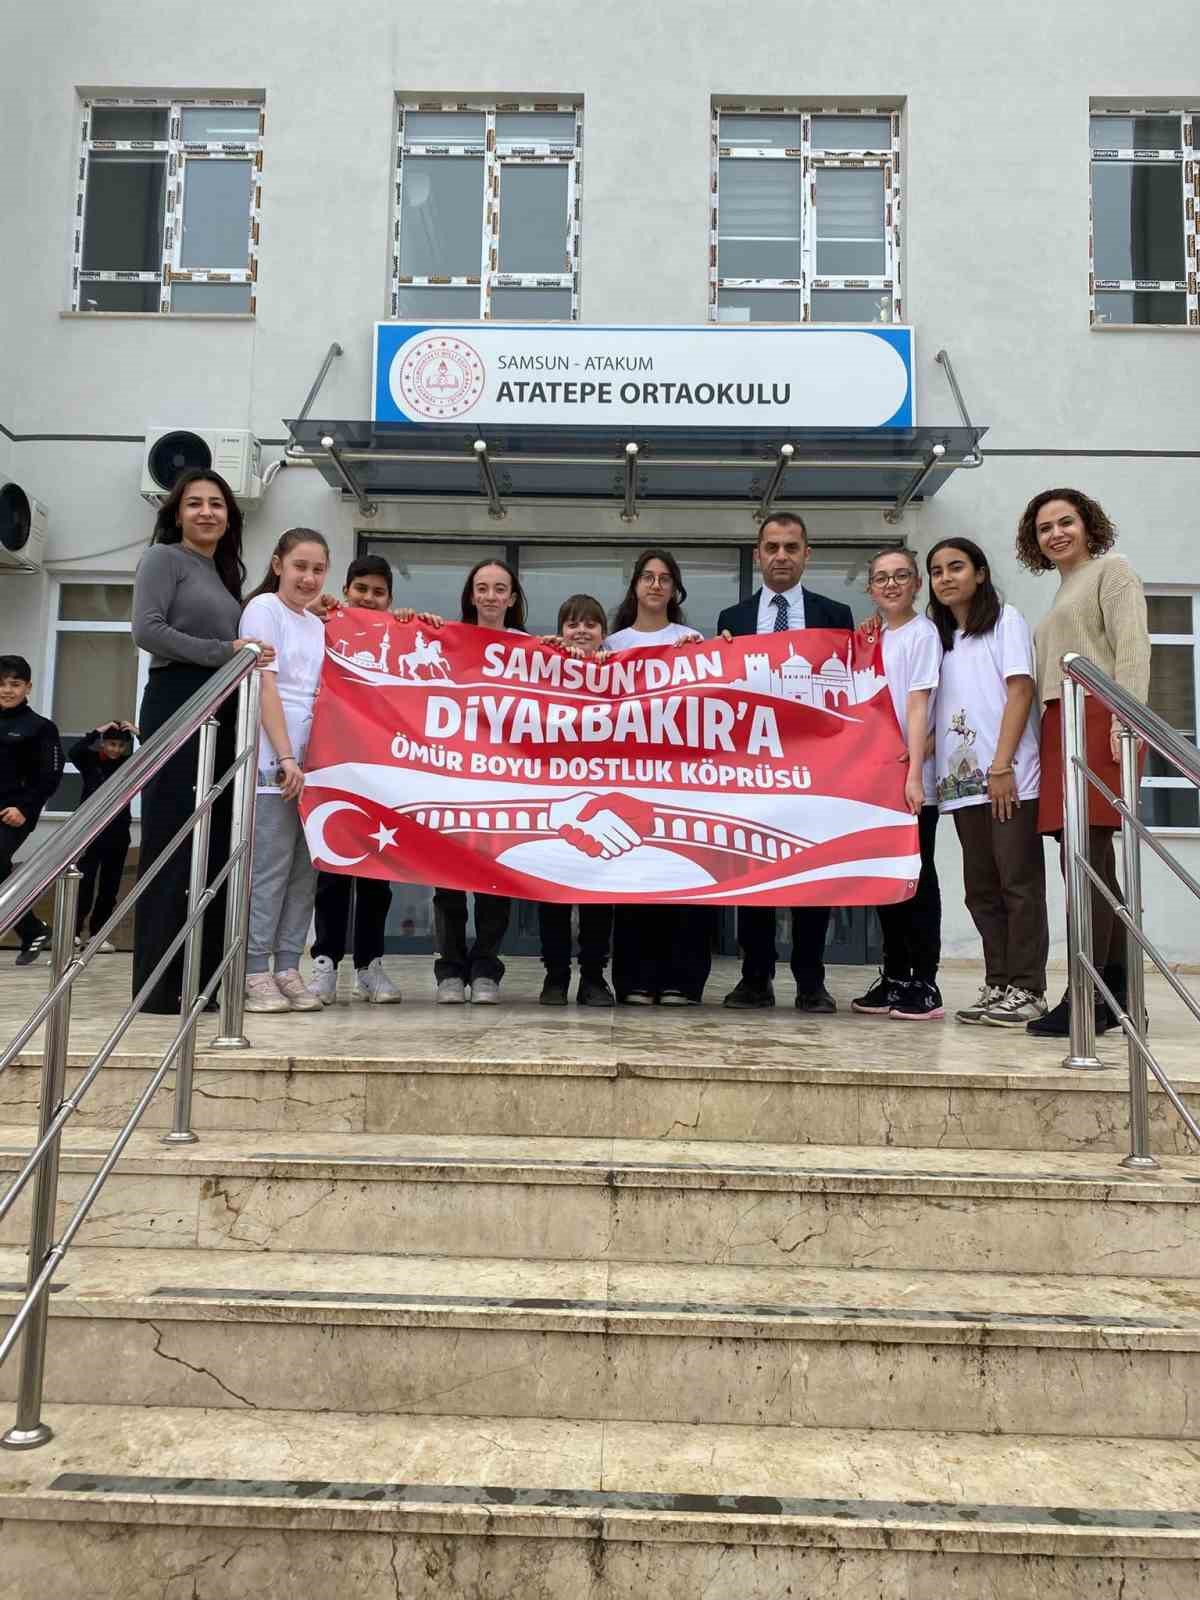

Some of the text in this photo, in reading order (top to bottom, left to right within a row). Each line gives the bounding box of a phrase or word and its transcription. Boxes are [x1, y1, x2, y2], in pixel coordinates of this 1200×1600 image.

[498, 355, 569, 370] SAMSUN
[584, 356, 653, 371] ATAKUM
[496, 381, 791, 405] ATATEPE ORTAOKULU
[482, 643, 724, 695] SAMSUN'DAN
[391, 734, 811, 790] ÖMÜR BOYU DOSTLUK KÖPRÜSÜ
